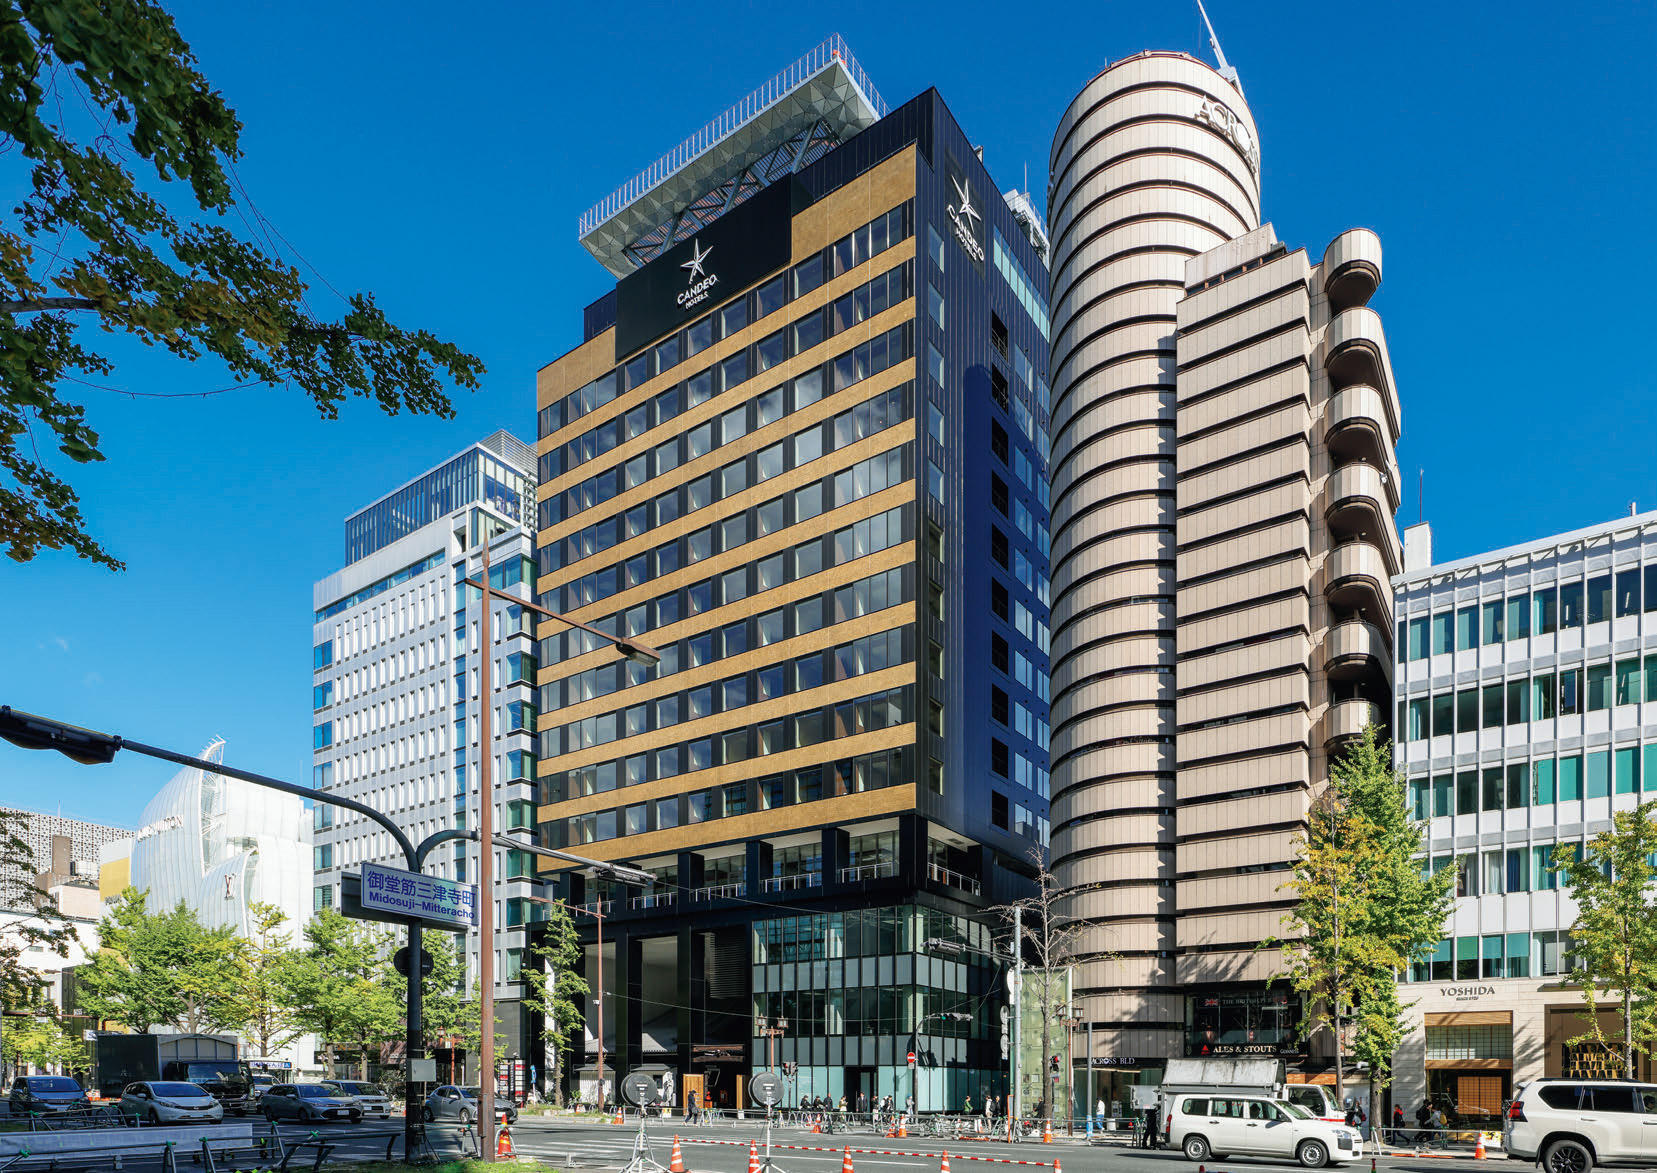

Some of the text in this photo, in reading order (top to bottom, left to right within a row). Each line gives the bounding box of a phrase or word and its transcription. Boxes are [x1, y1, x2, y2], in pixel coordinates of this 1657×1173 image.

[1194, 94, 1259, 174] ACRO
[948, 204, 984, 261] CANDEO
[677, 274, 718, 305] CANDEO
[685, 291, 709, 309] HOTELS
[367, 870, 476, 908] 御堂筋三津寺町
[369, 891, 475, 919] Midosuji-Mitteracho
[1440, 986, 1496, 996] YOSHIDA
[1120, 1057, 1135, 1065] BLD
[1213, 1045, 1234, 1053] ALES
[1236, 1045, 1242, 1053] &
[1244, 1045, 1277, 1053] STOUTS
